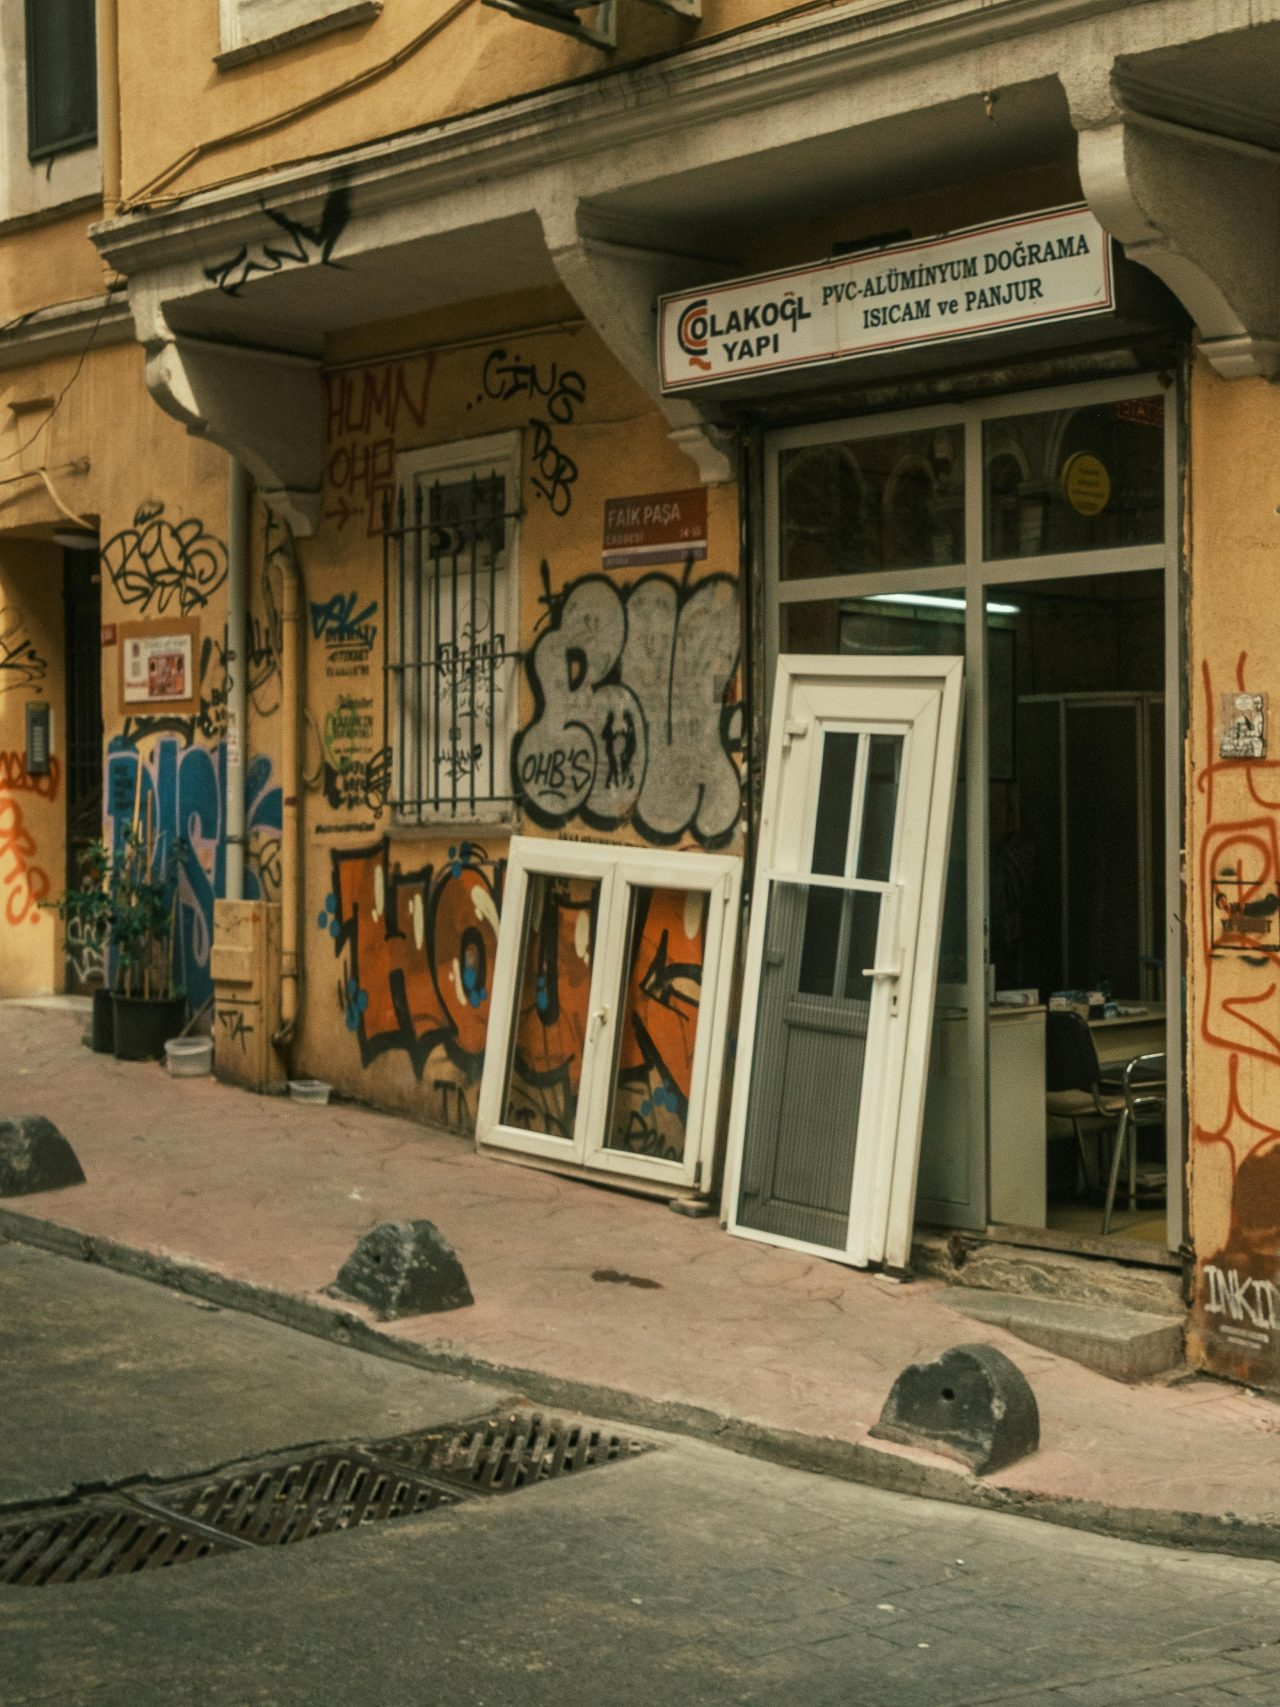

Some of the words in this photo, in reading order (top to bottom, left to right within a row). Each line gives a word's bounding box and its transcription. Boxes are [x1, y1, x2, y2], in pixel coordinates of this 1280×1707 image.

[821, 256, 979, 306] PVC-ALÜMİNYUM
[984, 234, 1090, 273] DOĞRAMA
[863, 299, 931, 329] ISICAM
[937, 299, 959, 316] ve
[965, 277, 1044, 312] PANJUR
[722, 333, 780, 362] YAPI
[608, 504, 640, 528] FAİK
[643, 502, 681, 526] PAŞA
